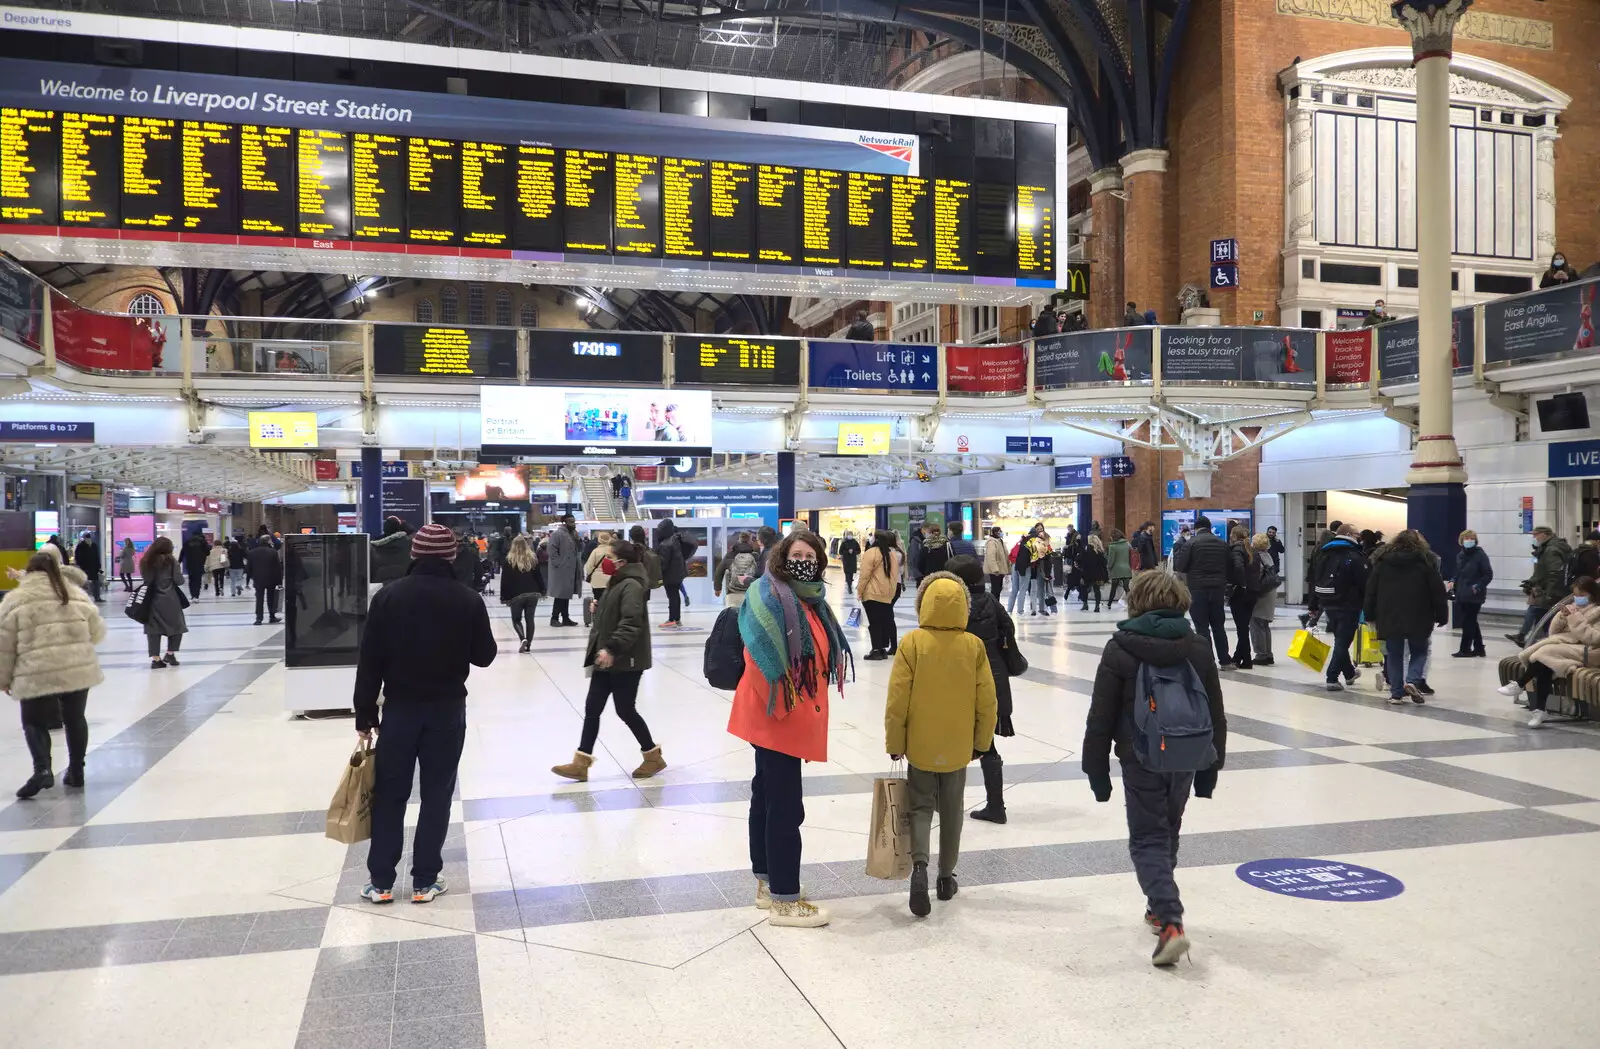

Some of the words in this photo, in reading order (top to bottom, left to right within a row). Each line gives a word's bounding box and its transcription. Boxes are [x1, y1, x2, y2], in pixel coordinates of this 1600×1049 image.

[3, 11, 72, 28] Departures
[39, 78, 128, 102] Welcome
[129, 87, 148, 103] to
[153, 84, 258, 112] Liverpool
[261, 93, 328, 117] Street
[335, 98, 413, 123] Station
[858, 134, 915, 147] NetworkRail
[313, 240, 334, 249] East
[814, 268, 833, 277] West
[1504, 307, 1525, 318] Nice
[1526, 303, 1547, 314] one,
[1503, 320, 1524, 331] East
[1526, 313, 1559, 327] Anglia.
[1168, 335, 1205, 346] Looking
[1207, 335, 1223, 344] for
[1385, 339, 1396, 350] All
[1396, 337, 1416, 348] clear
[572, 341, 604, 356] 17:01
[1037, 344, 1048, 352] Now
[1167, 346, 1186, 356] less
[1187, 346, 1210, 357] busy
[1212, 346, 1240, 356] train?
[876, 351, 896, 362] Lift
[1335, 353, 1362, 361] London
[982, 359, 1009, 367] Welcome
[1332, 361, 1365, 369] Liverpool
[844, 369, 882, 381] Toilets
[486, 417, 518, 425] Portrait
[1077, 469, 1085, 478] Lift
[1248, 864, 1347, 878] Customer
[1264, 876, 1309, 887] Lift
[1296, 884, 1331, 893] upper
